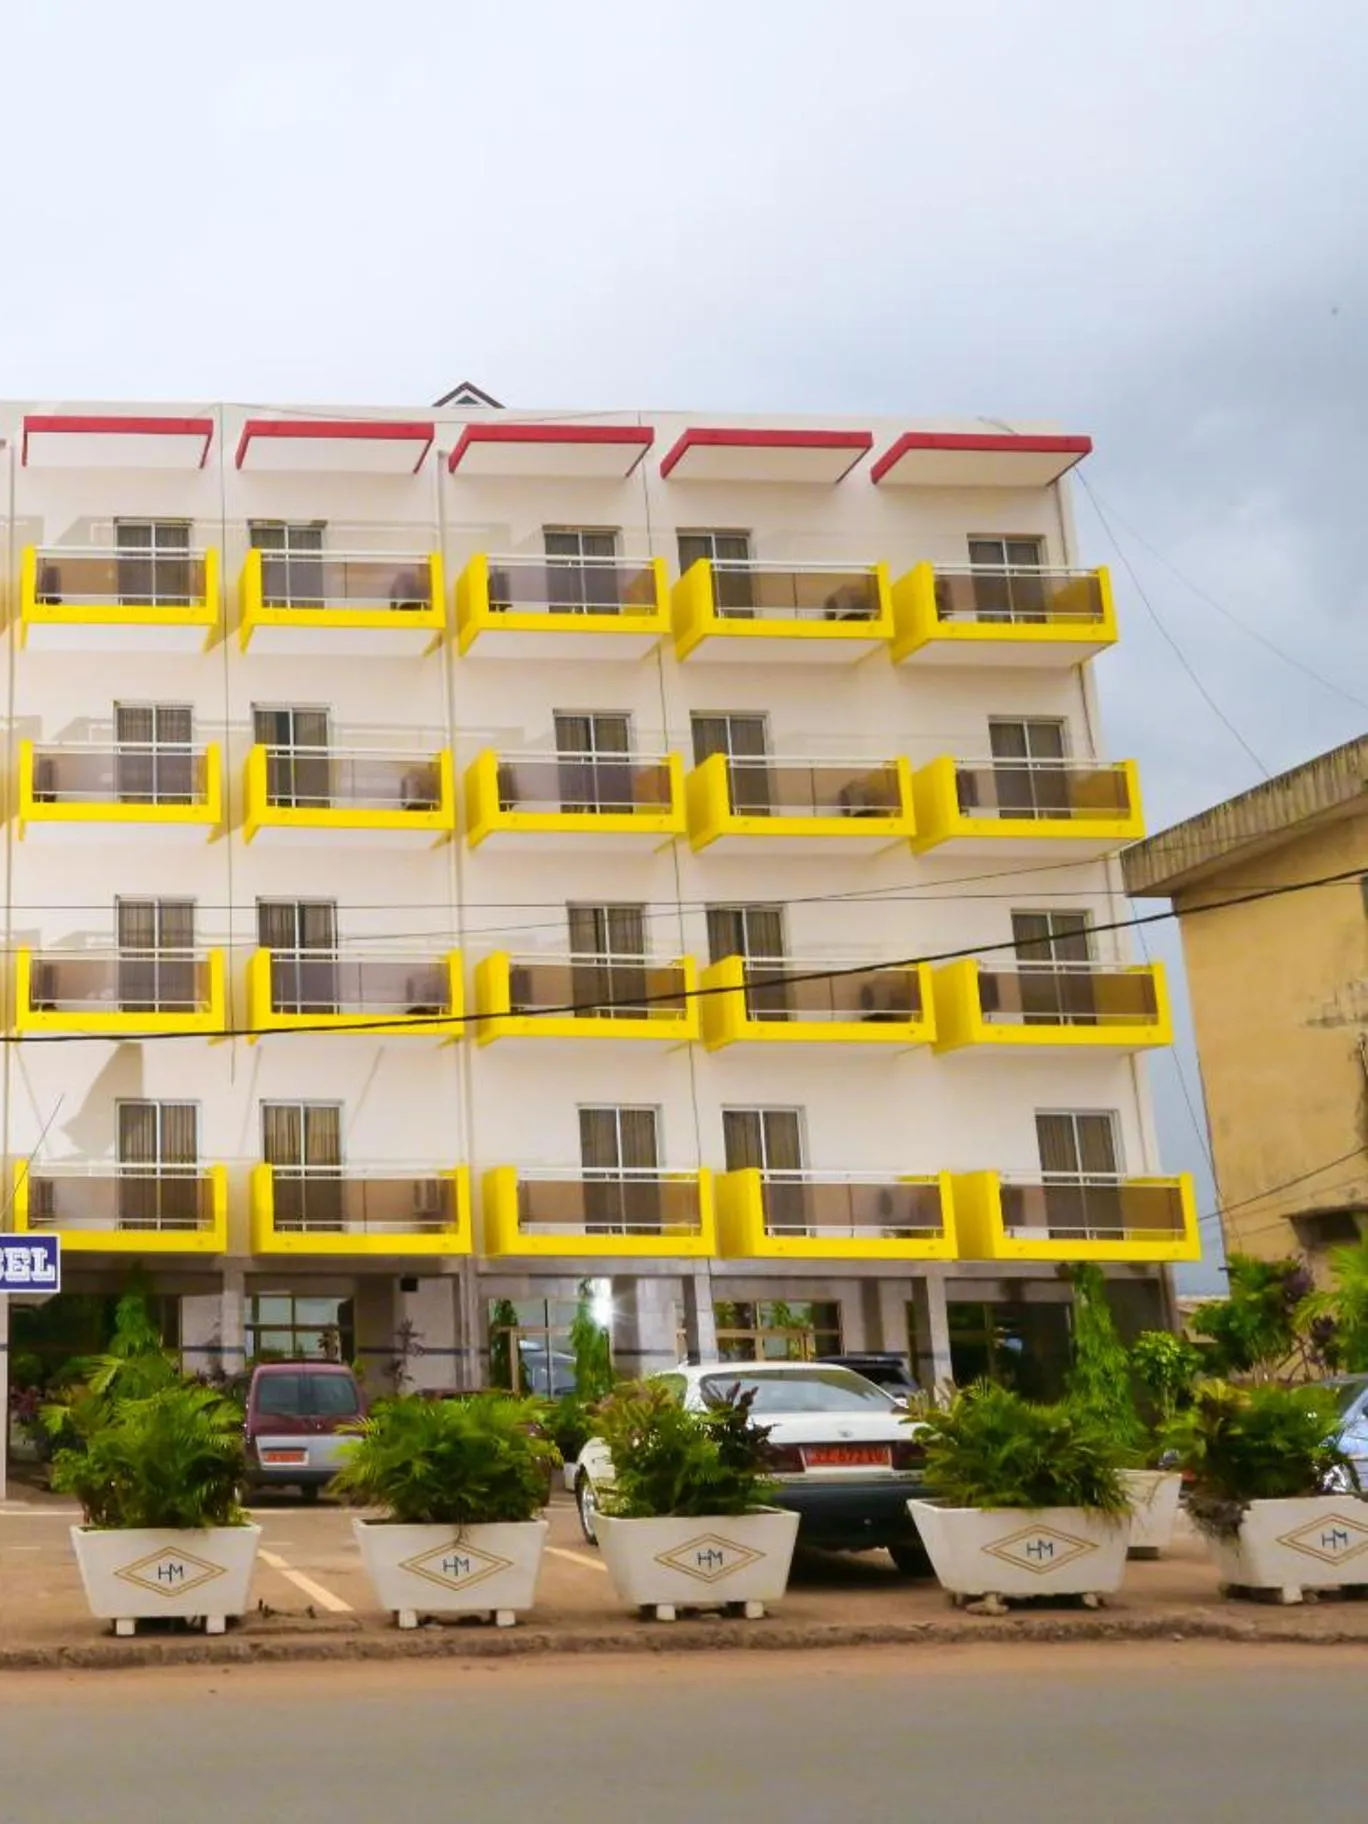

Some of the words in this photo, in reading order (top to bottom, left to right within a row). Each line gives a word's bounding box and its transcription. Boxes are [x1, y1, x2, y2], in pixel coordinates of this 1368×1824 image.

[1322, 1528, 1348, 1549] HM
[697, 1548, 723, 1568] HM
[1027, 1539, 1053, 1560] HM
[158, 1563, 184, 1583] HM
[443, 1555, 469, 1576] HM
